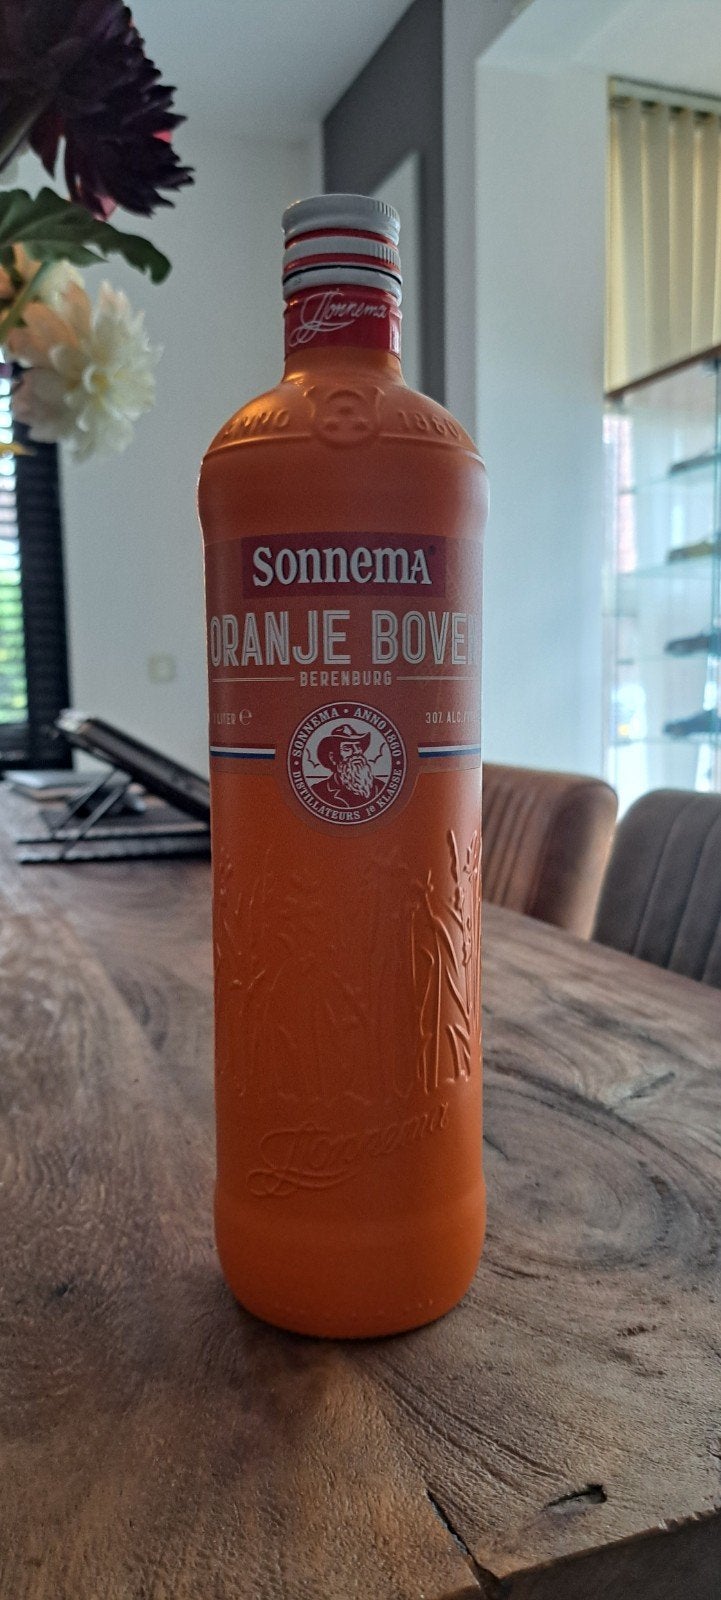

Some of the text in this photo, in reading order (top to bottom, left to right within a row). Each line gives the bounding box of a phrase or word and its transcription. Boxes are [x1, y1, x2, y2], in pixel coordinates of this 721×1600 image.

[288, 288, 387, 347] Sonnema
[210, 609, 350, 667] ORANJE
[300, 670, 392, 687] BERENBURG
[292, 707, 340, 758] SONNEMA
[353, 707, 387, 731] ANNO
[292, 771, 361, 820] DISTILLATEURS
[376, 769, 402, 807] KLASSE
